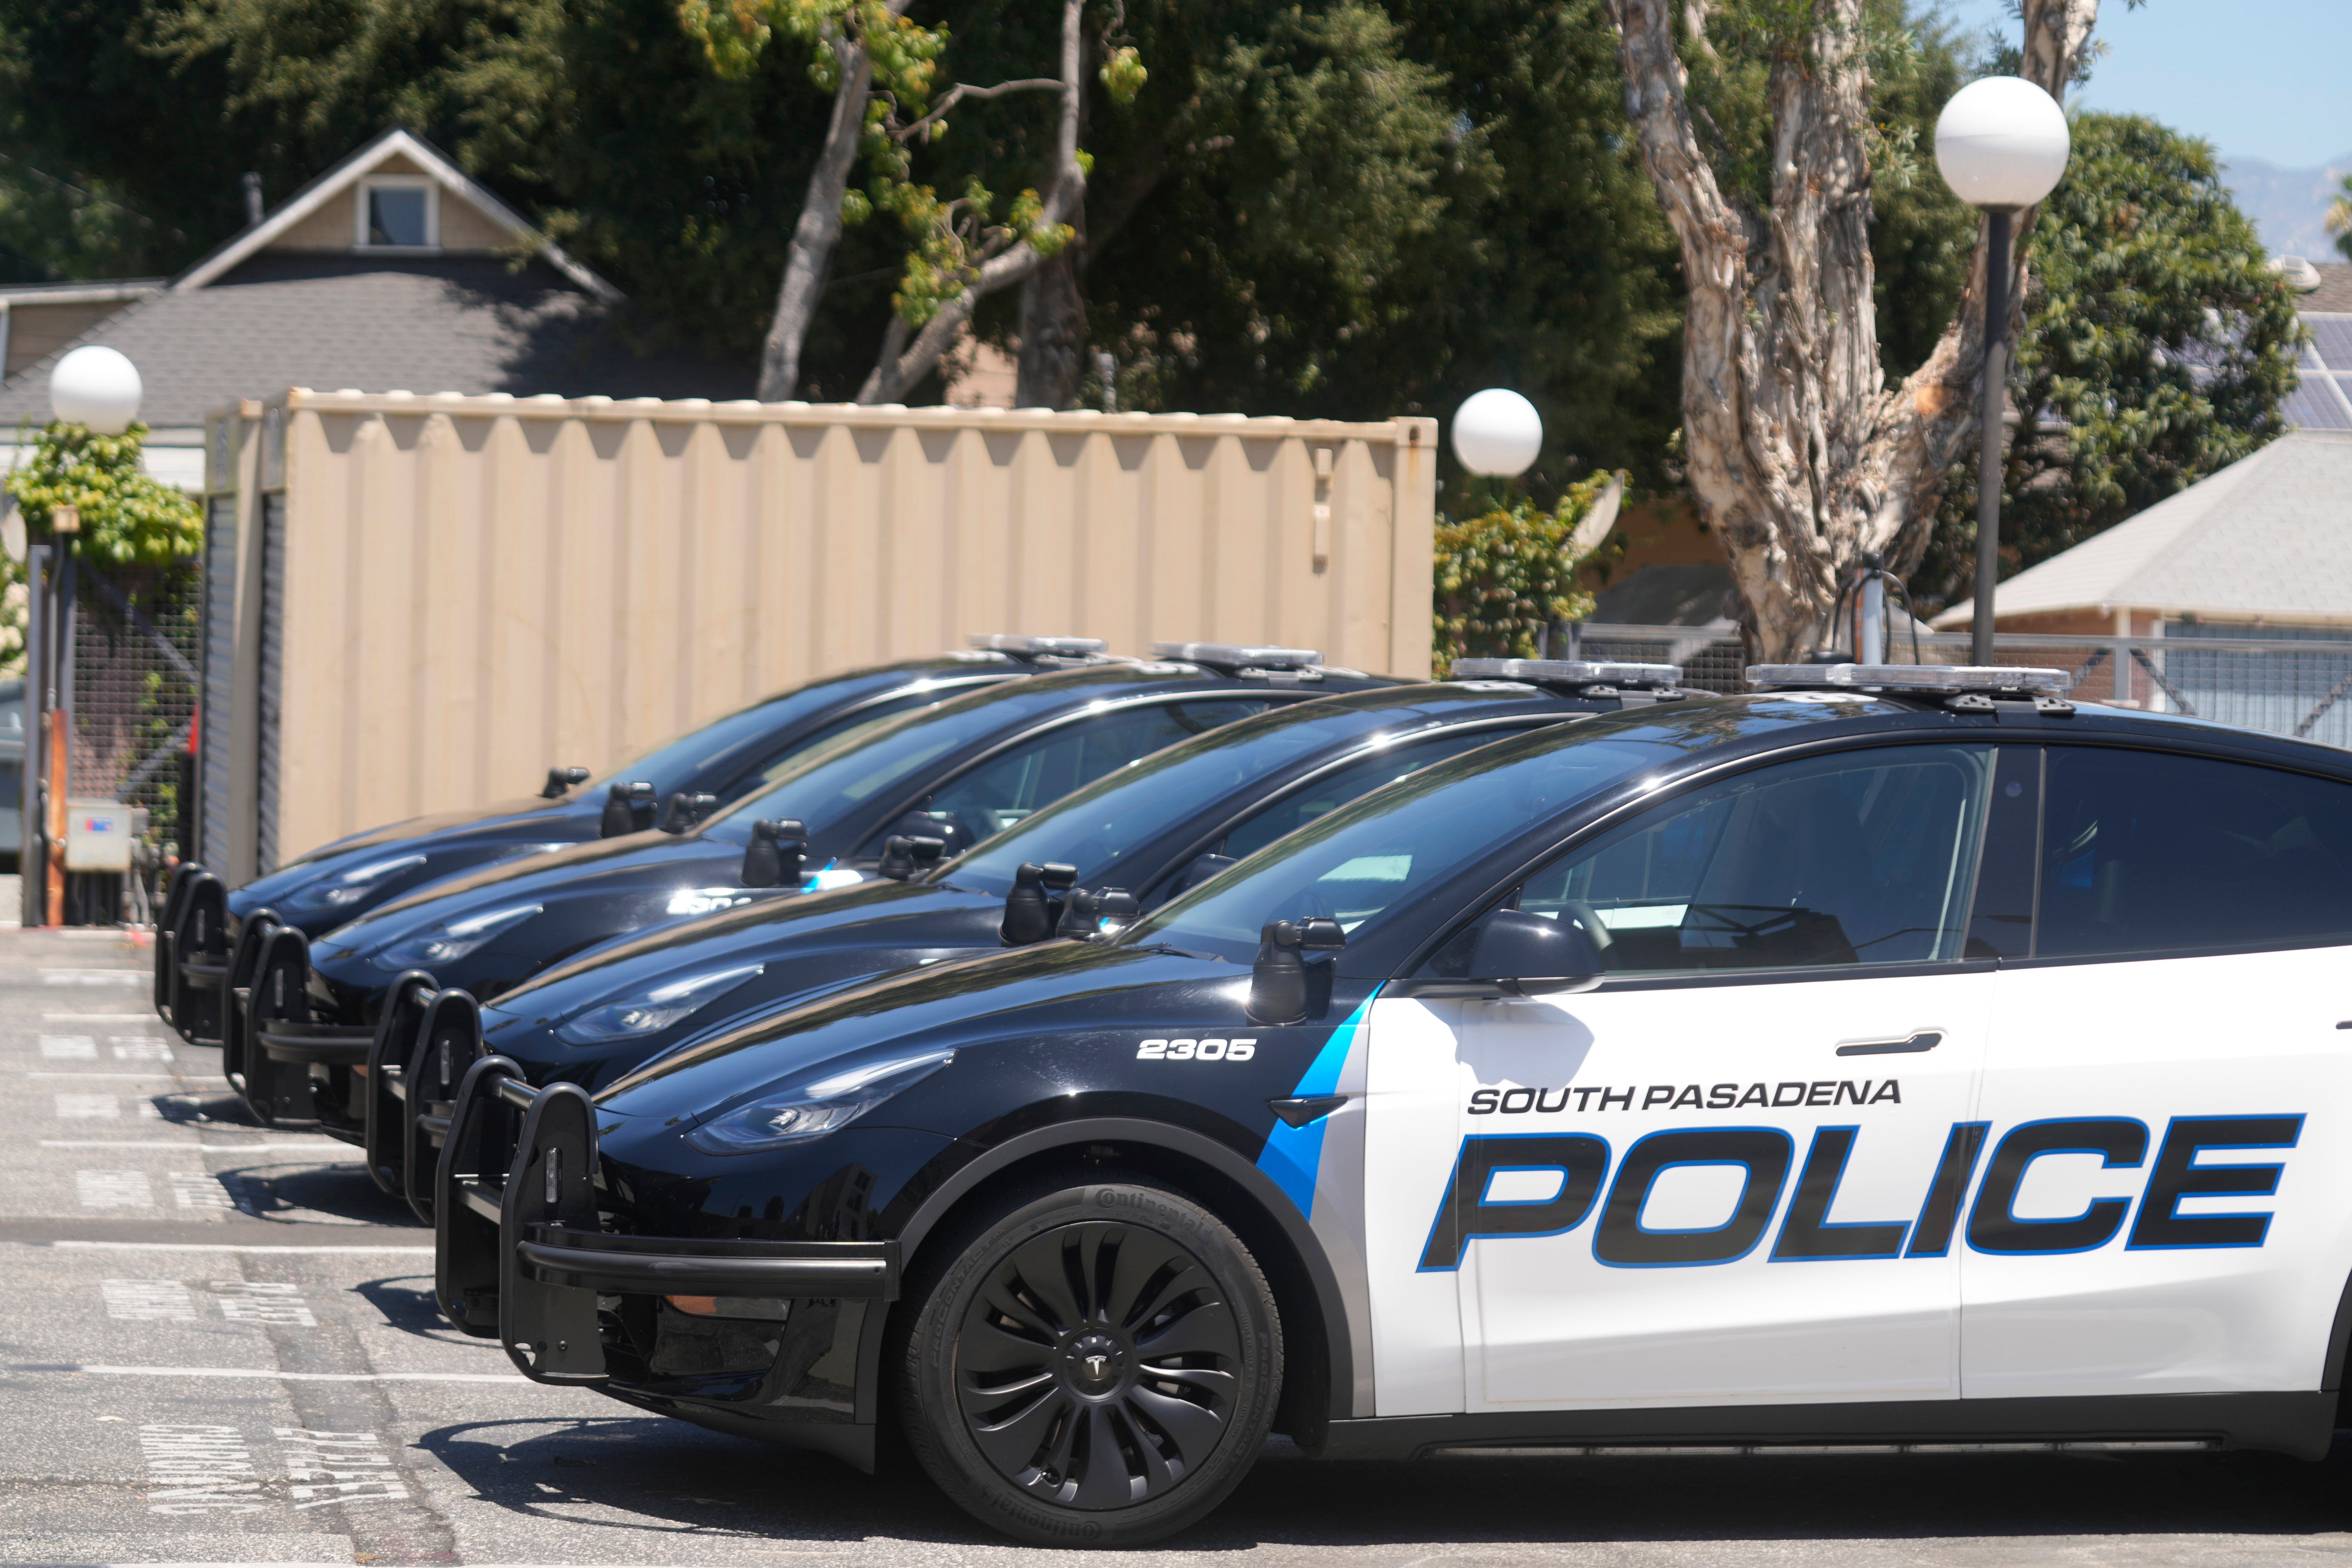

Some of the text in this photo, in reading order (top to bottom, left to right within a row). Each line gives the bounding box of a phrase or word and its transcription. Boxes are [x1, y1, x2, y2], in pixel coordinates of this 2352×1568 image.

[1136, 1038, 1257, 1061] 2305
[1467, 1080, 1900, 1114] SOUTH PASADENA
[1095, 1188, 1205, 1237] Continental
[1415, 1113, 2307, 1273] POLICE
[138, 1424, 266, 1515] CHARGING
[272, 1427, 409, 1510] EV FLEET
